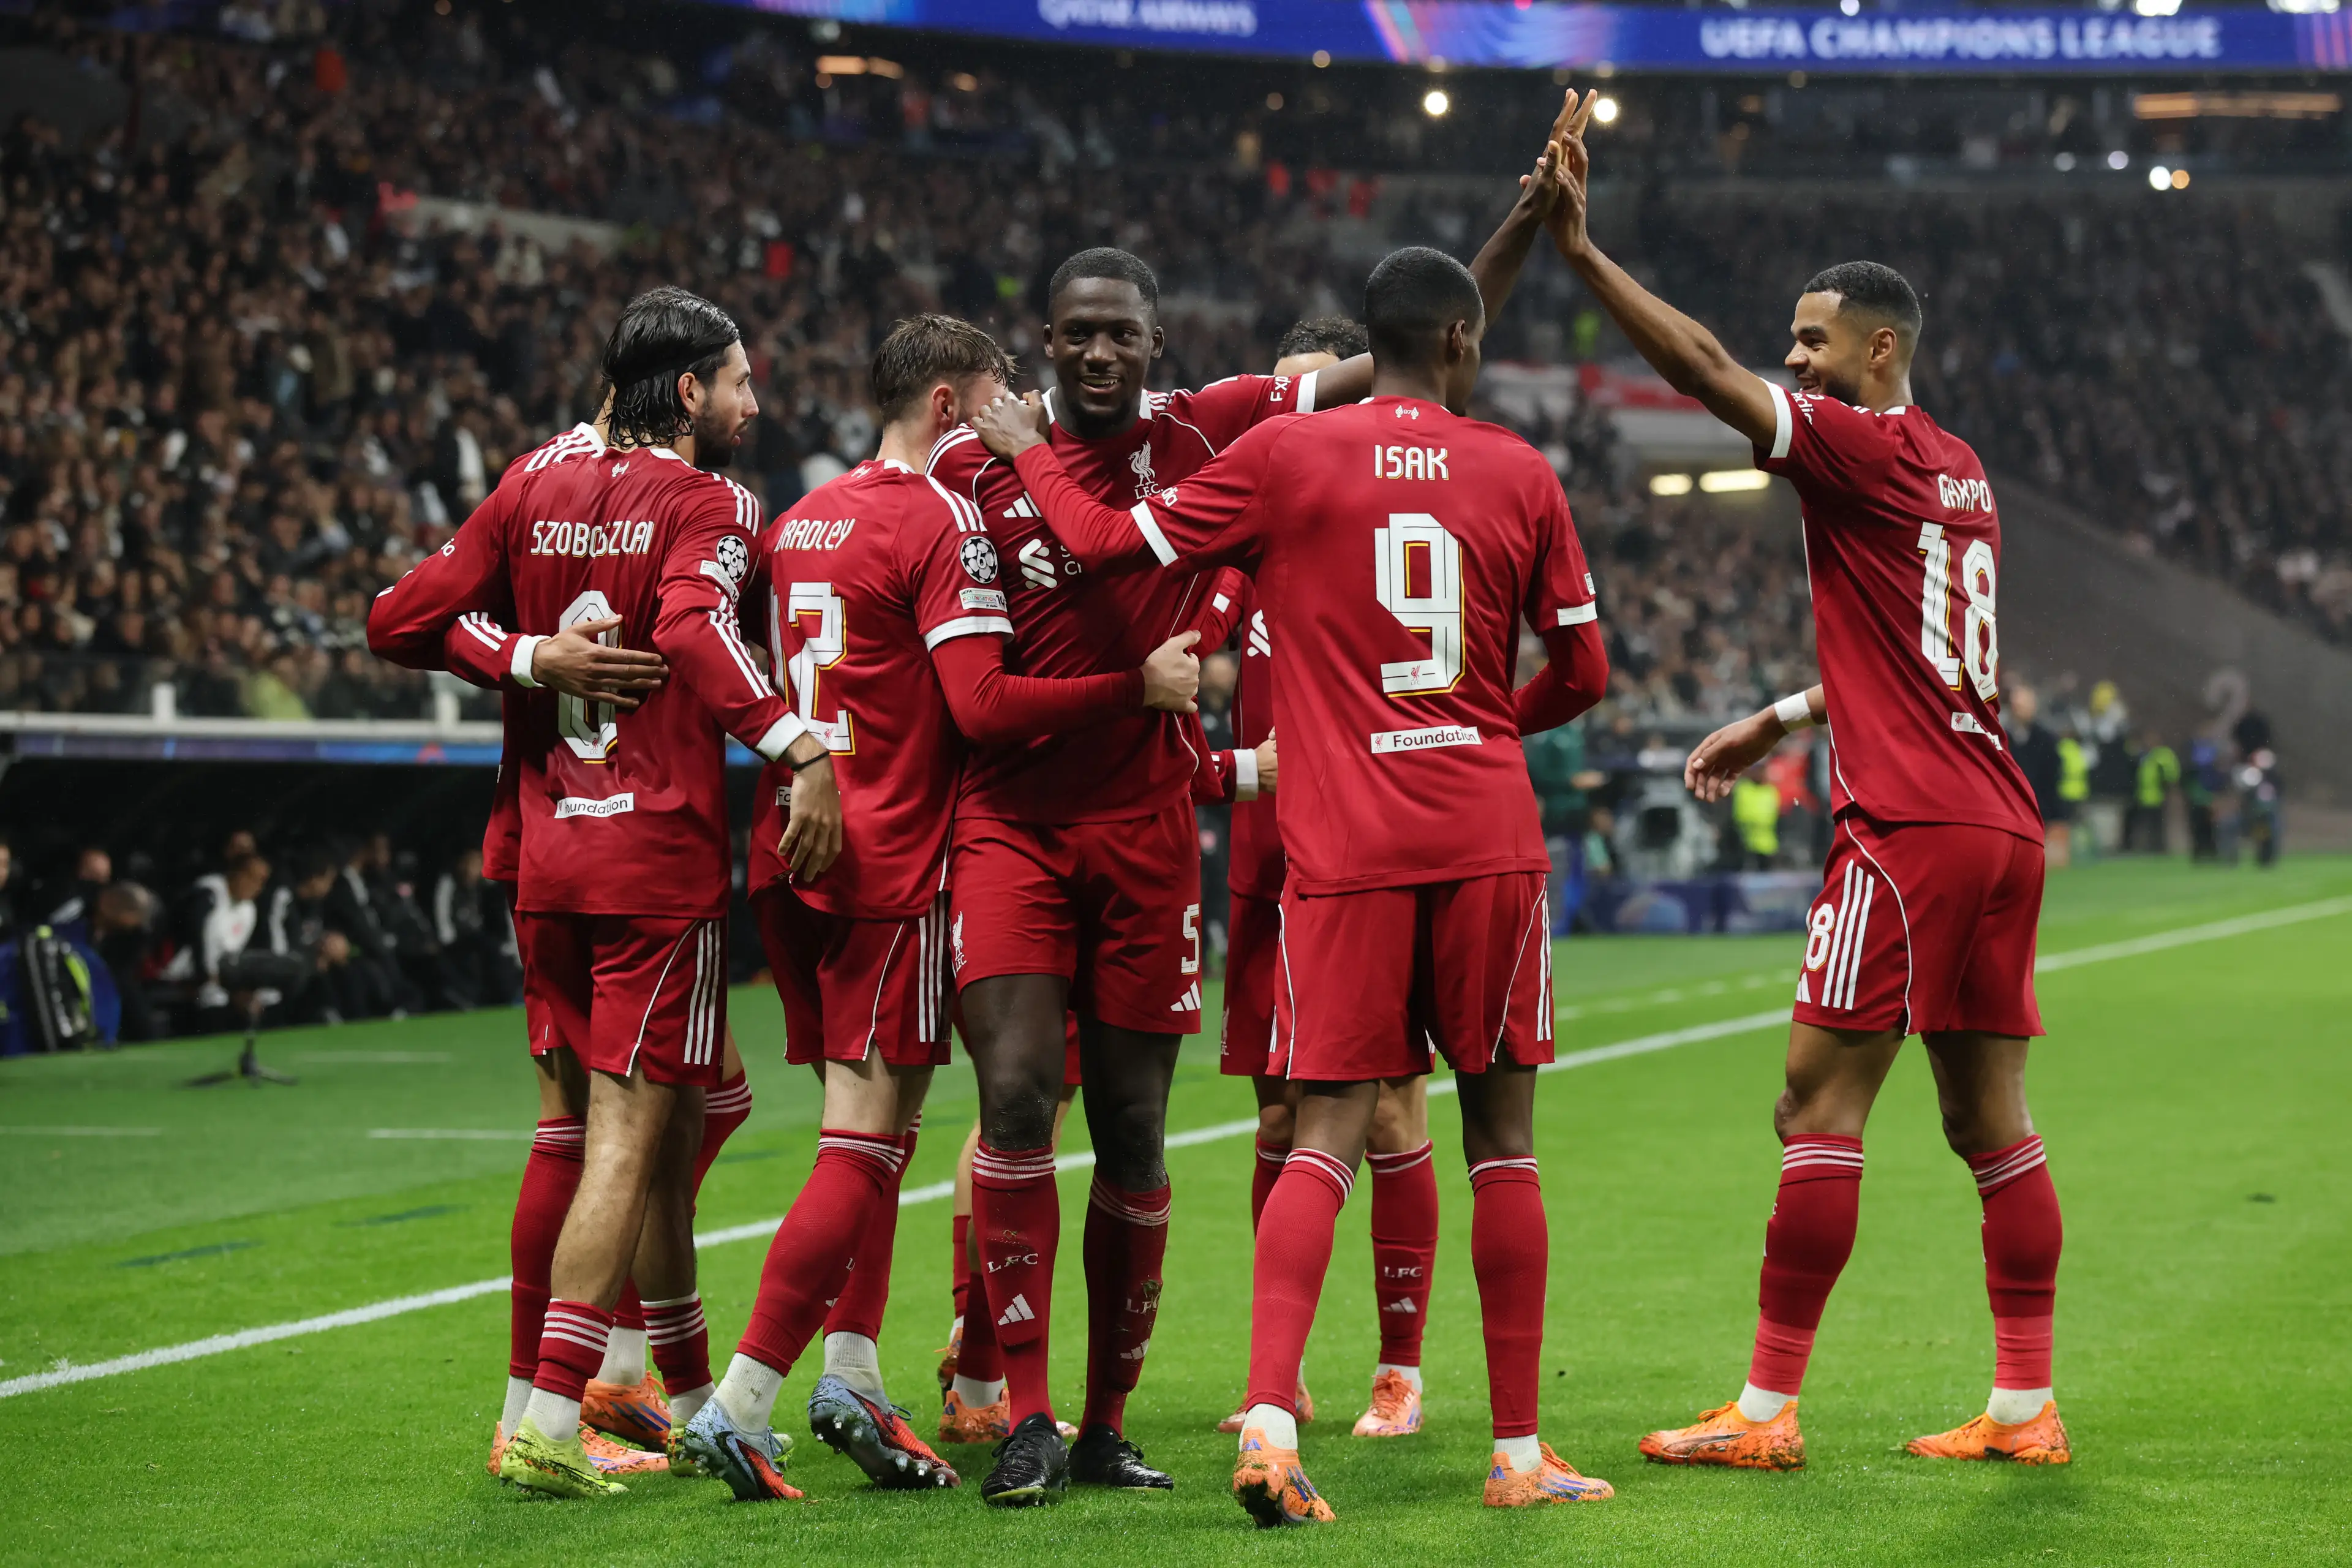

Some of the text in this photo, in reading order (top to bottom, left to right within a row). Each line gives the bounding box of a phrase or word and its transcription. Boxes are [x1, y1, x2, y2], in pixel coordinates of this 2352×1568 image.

[1700, 17, 2223, 59] UEFA CHAMPIONS LEAGUE
[1374, 445, 1449, 480] ISAK
[1938, 473, 1992, 513] GAKPO
[530, 521, 654, 559] SZOBOSZLAI
[1374, 513, 1465, 697] 9
[1917, 521, 1999, 703] 18
[1393, 729, 1477, 748] Foundation
[1181, 903, 1199, 975] 5
[1804, 903, 1836, 971] 8
[987, 1253, 1039, 1273] LFC
[1384, 1266, 1423, 1278] LFC
